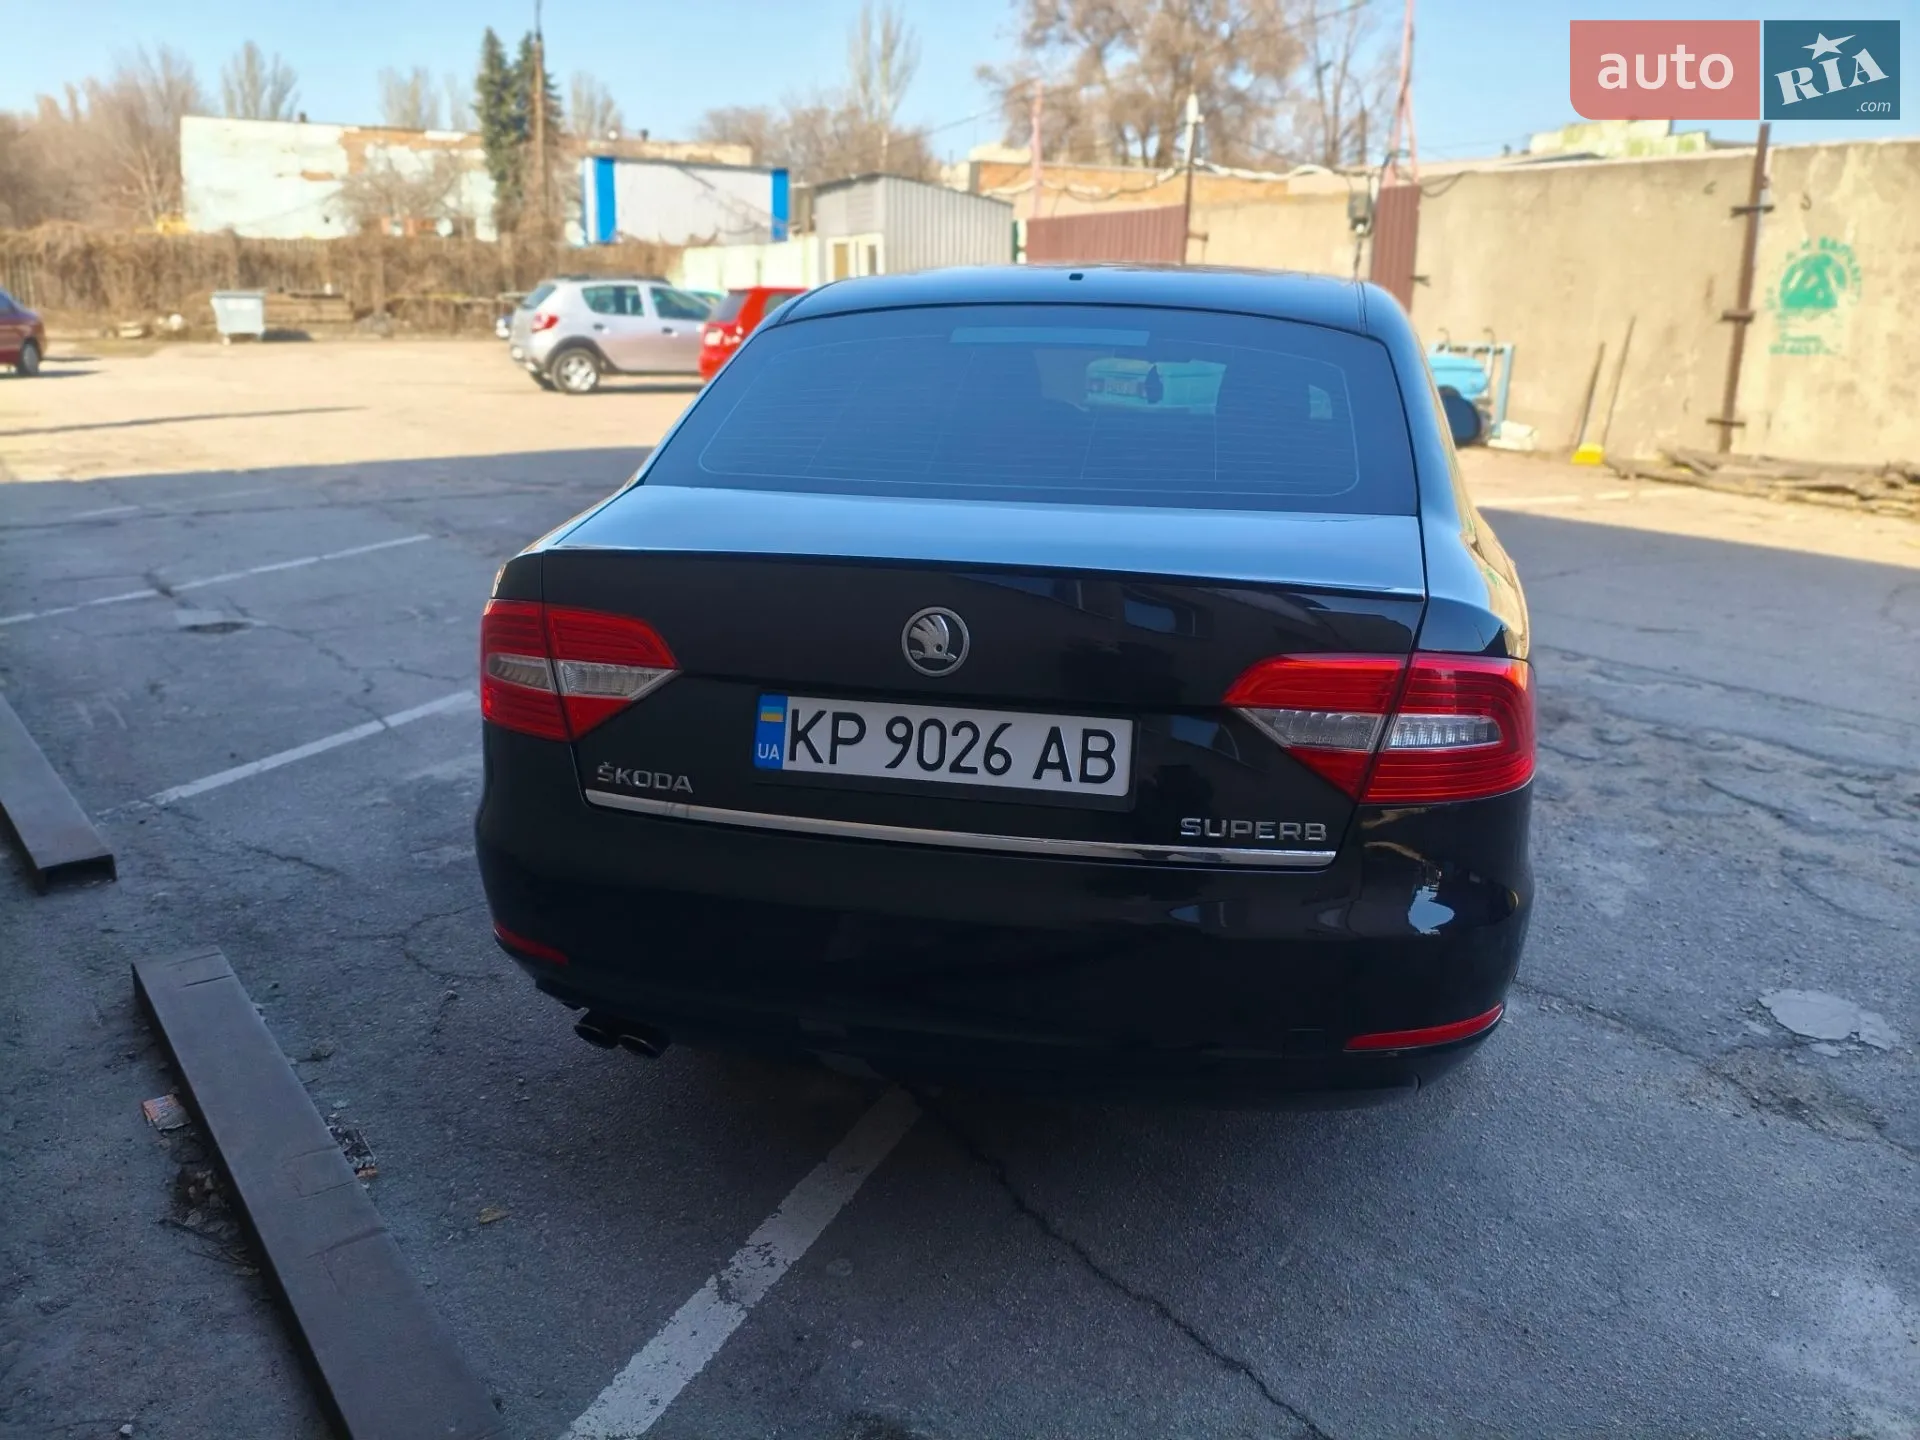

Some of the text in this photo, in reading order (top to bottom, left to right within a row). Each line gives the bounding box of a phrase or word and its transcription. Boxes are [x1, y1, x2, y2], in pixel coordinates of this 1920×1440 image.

[757, 743, 780, 760] UA
[788, 708, 1117, 784] KP 9026 AB
[597, 761, 694, 794] ŠKODA
[1180, 817, 1327, 841] SUPERB
